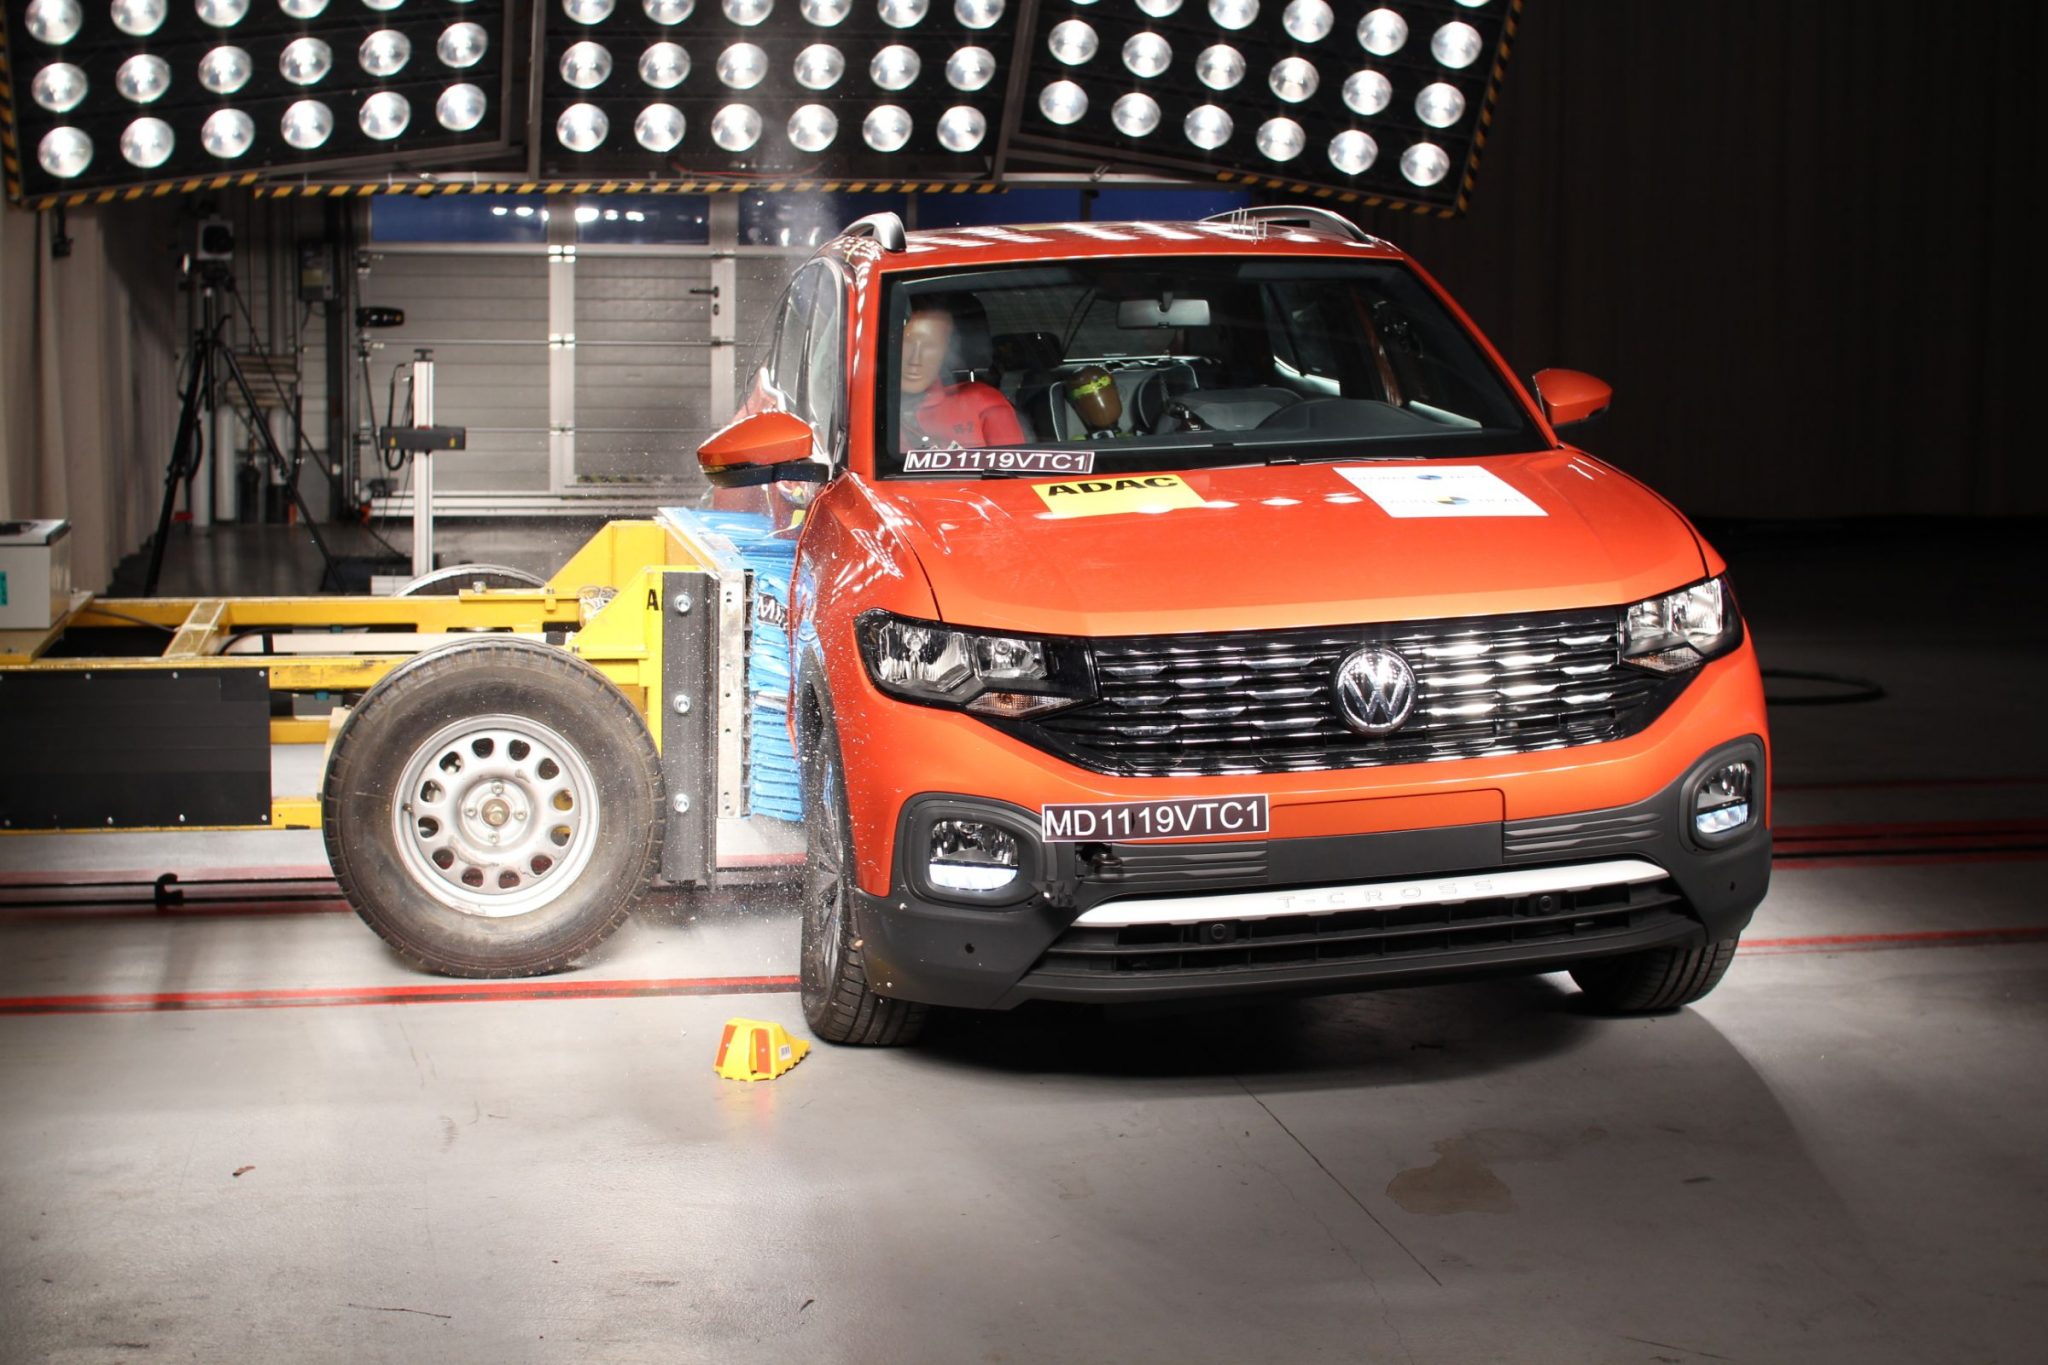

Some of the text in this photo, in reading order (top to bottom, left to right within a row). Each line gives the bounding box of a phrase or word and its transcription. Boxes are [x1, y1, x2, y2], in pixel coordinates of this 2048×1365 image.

[907, 451, 1085, 470] MD1119VTC1
[1048, 477, 1178, 496] ADAC
[646, 588, 663, 611] A
[1045, 800, 1259, 837] MD1119VTC1
[1277, 879, 1493, 908] T-CROSS
